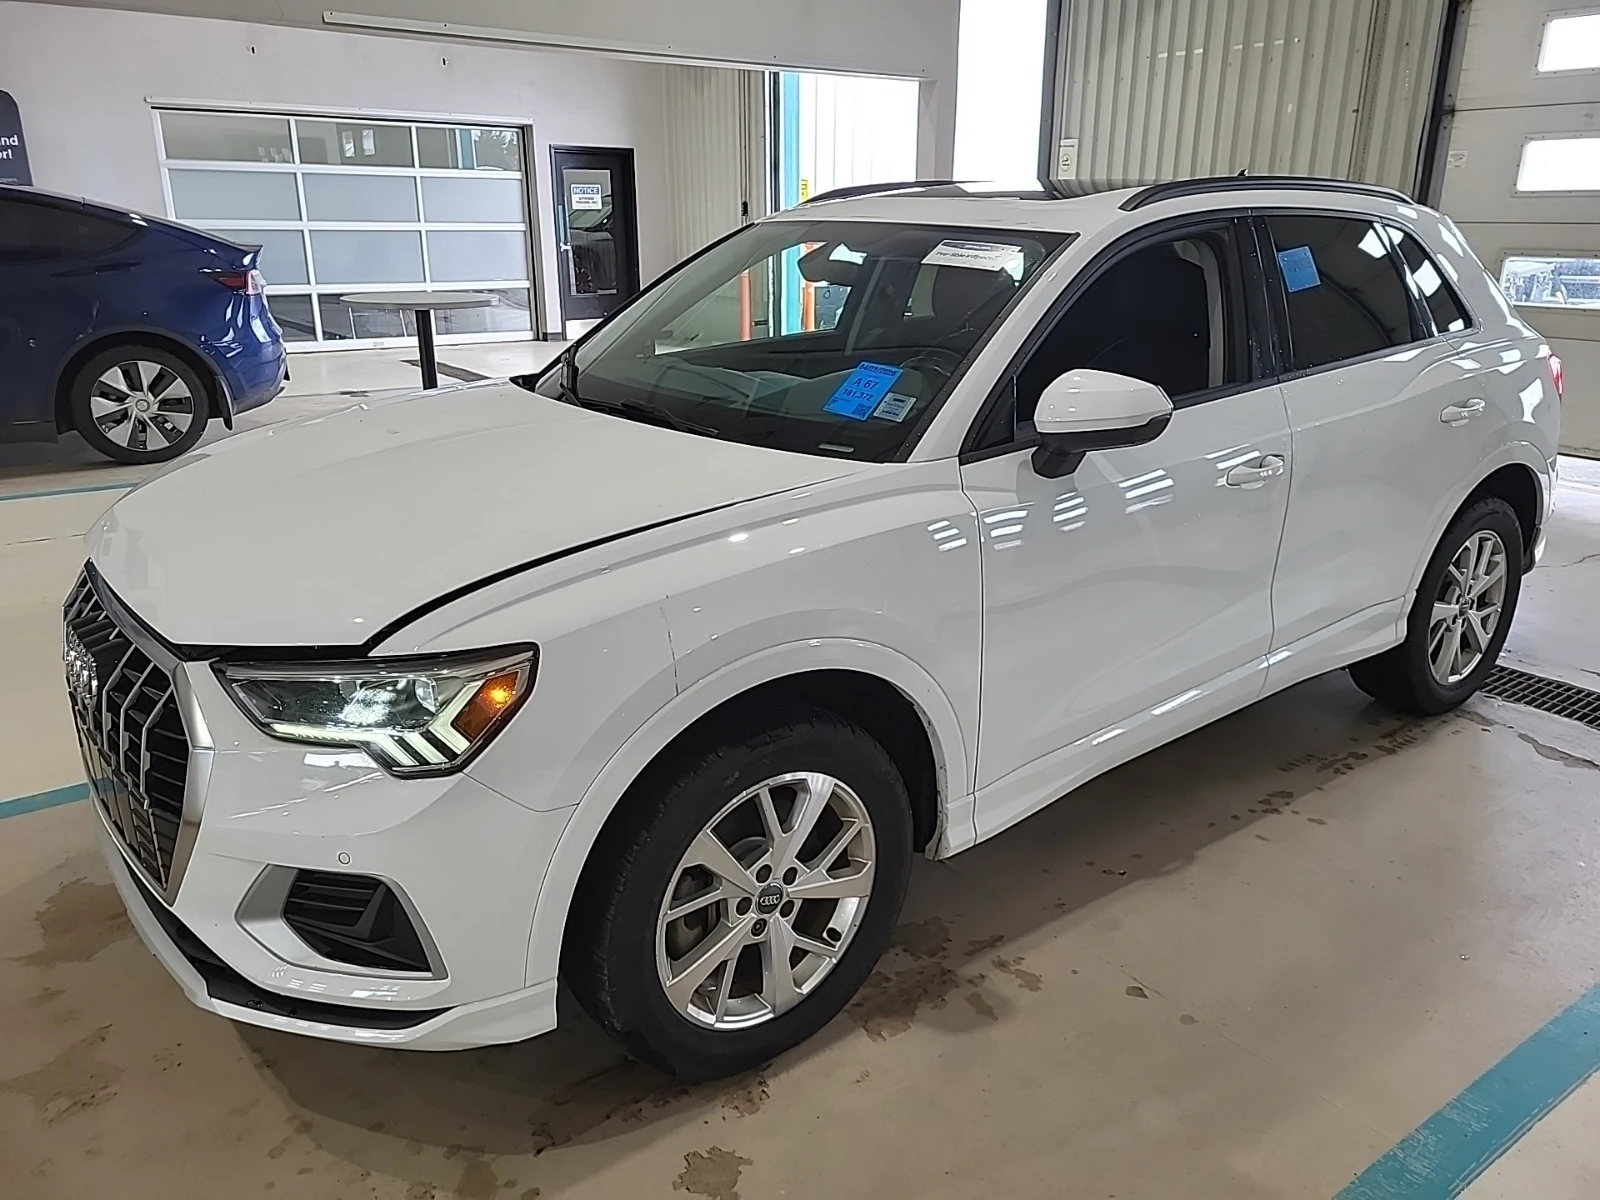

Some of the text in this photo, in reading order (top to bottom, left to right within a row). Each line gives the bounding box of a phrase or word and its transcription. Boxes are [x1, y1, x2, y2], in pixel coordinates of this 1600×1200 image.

[0, 134, 18, 145] nd
[852, 377, 879, 390] A 67
